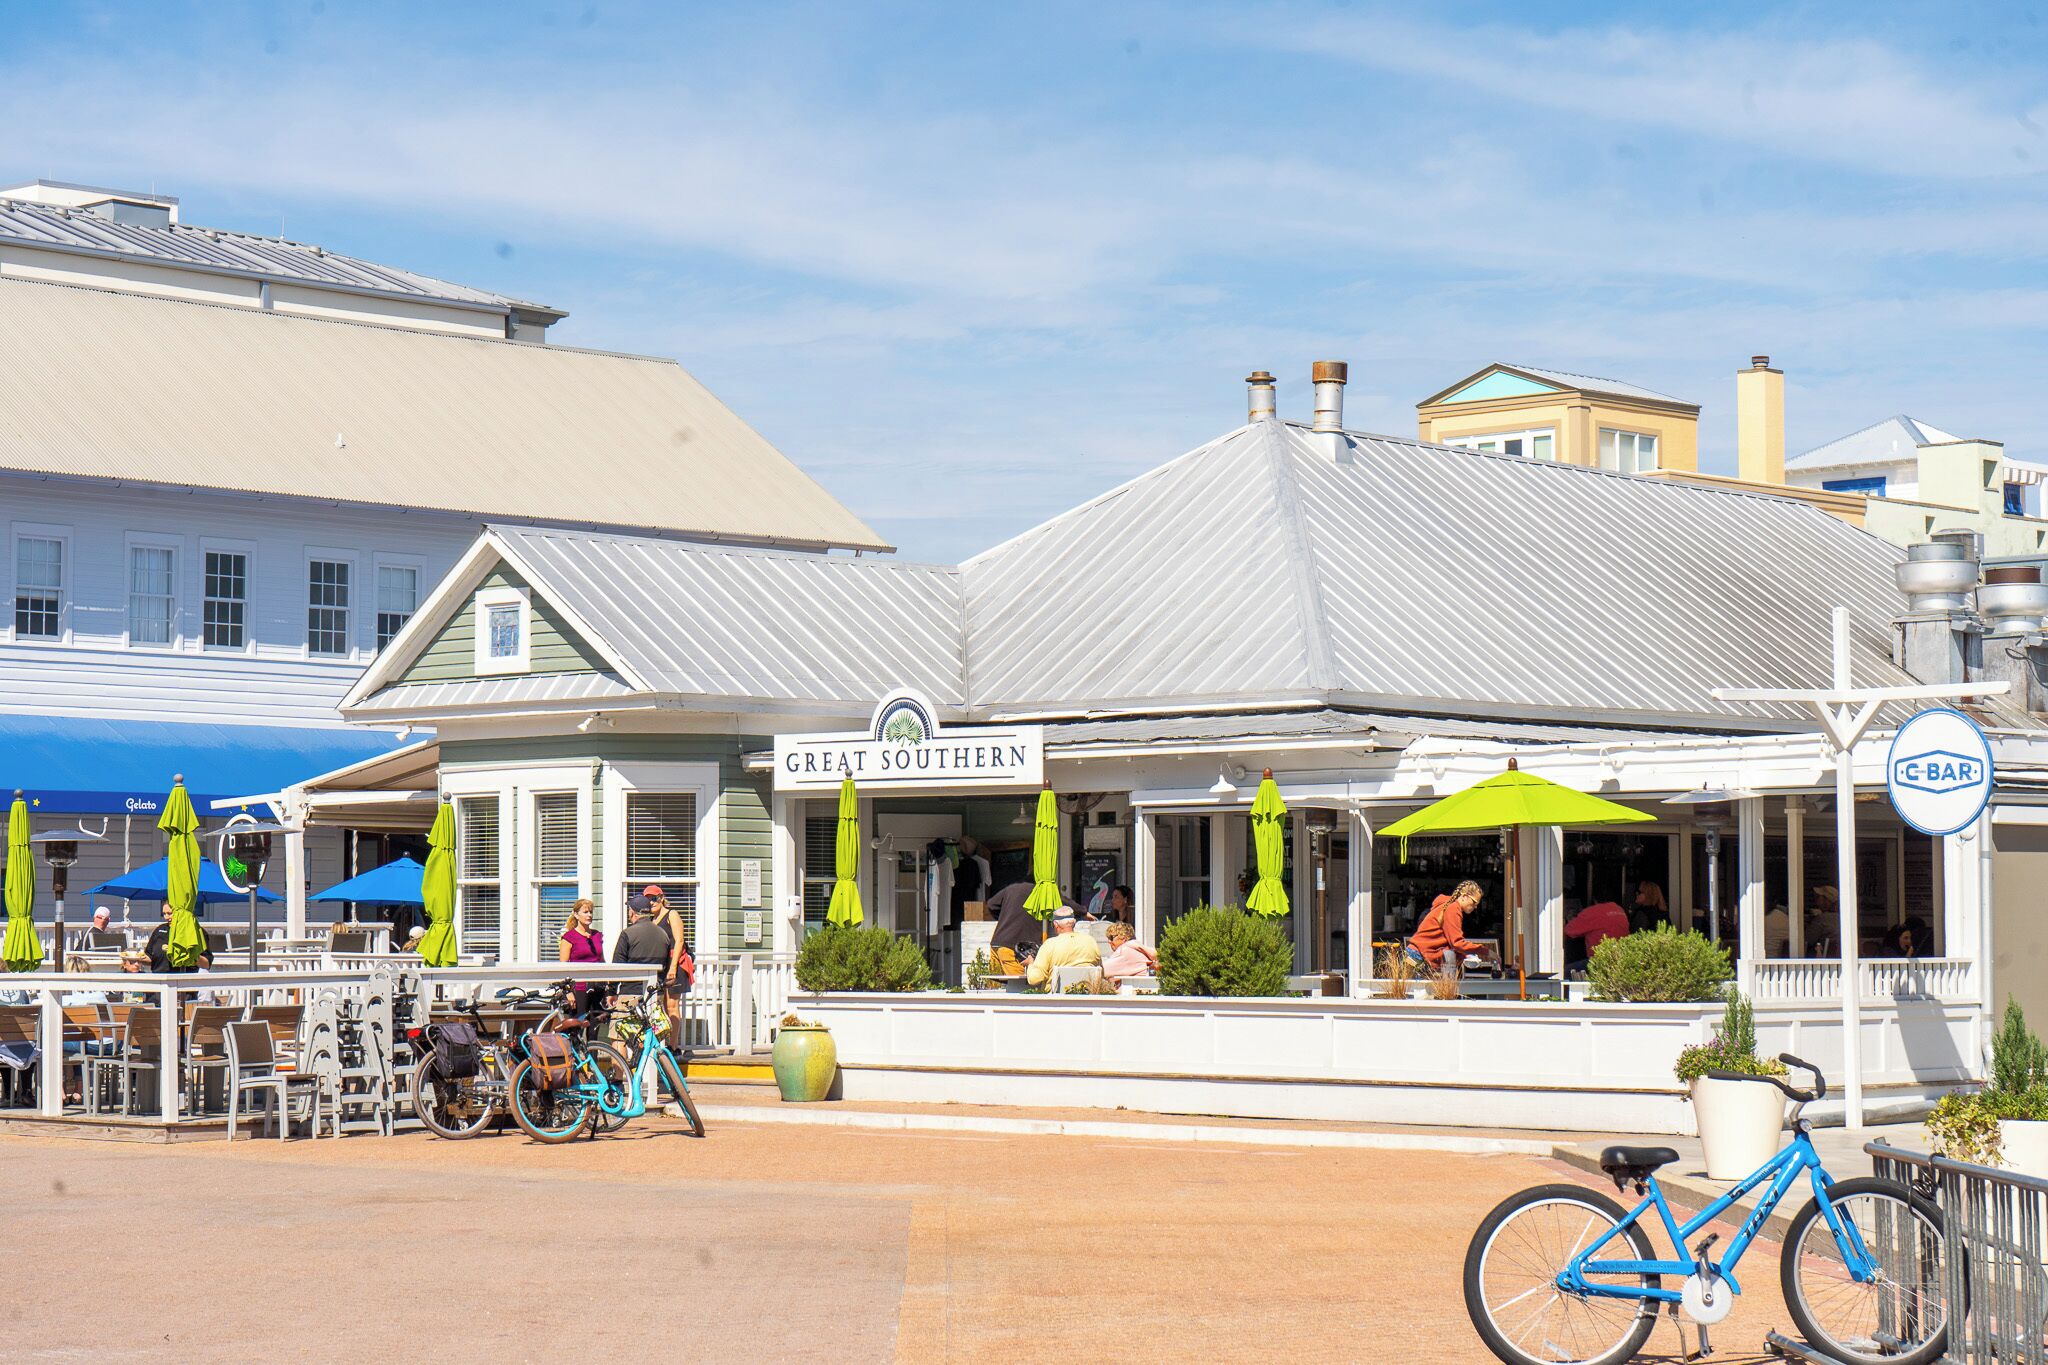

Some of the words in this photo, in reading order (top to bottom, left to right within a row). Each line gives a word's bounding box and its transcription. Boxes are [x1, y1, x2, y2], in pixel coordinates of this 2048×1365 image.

[786, 751, 867, 773] GREAT
[881, 745, 1027, 770] SOUTHERN
[125, 797, 157, 812] Gelato
